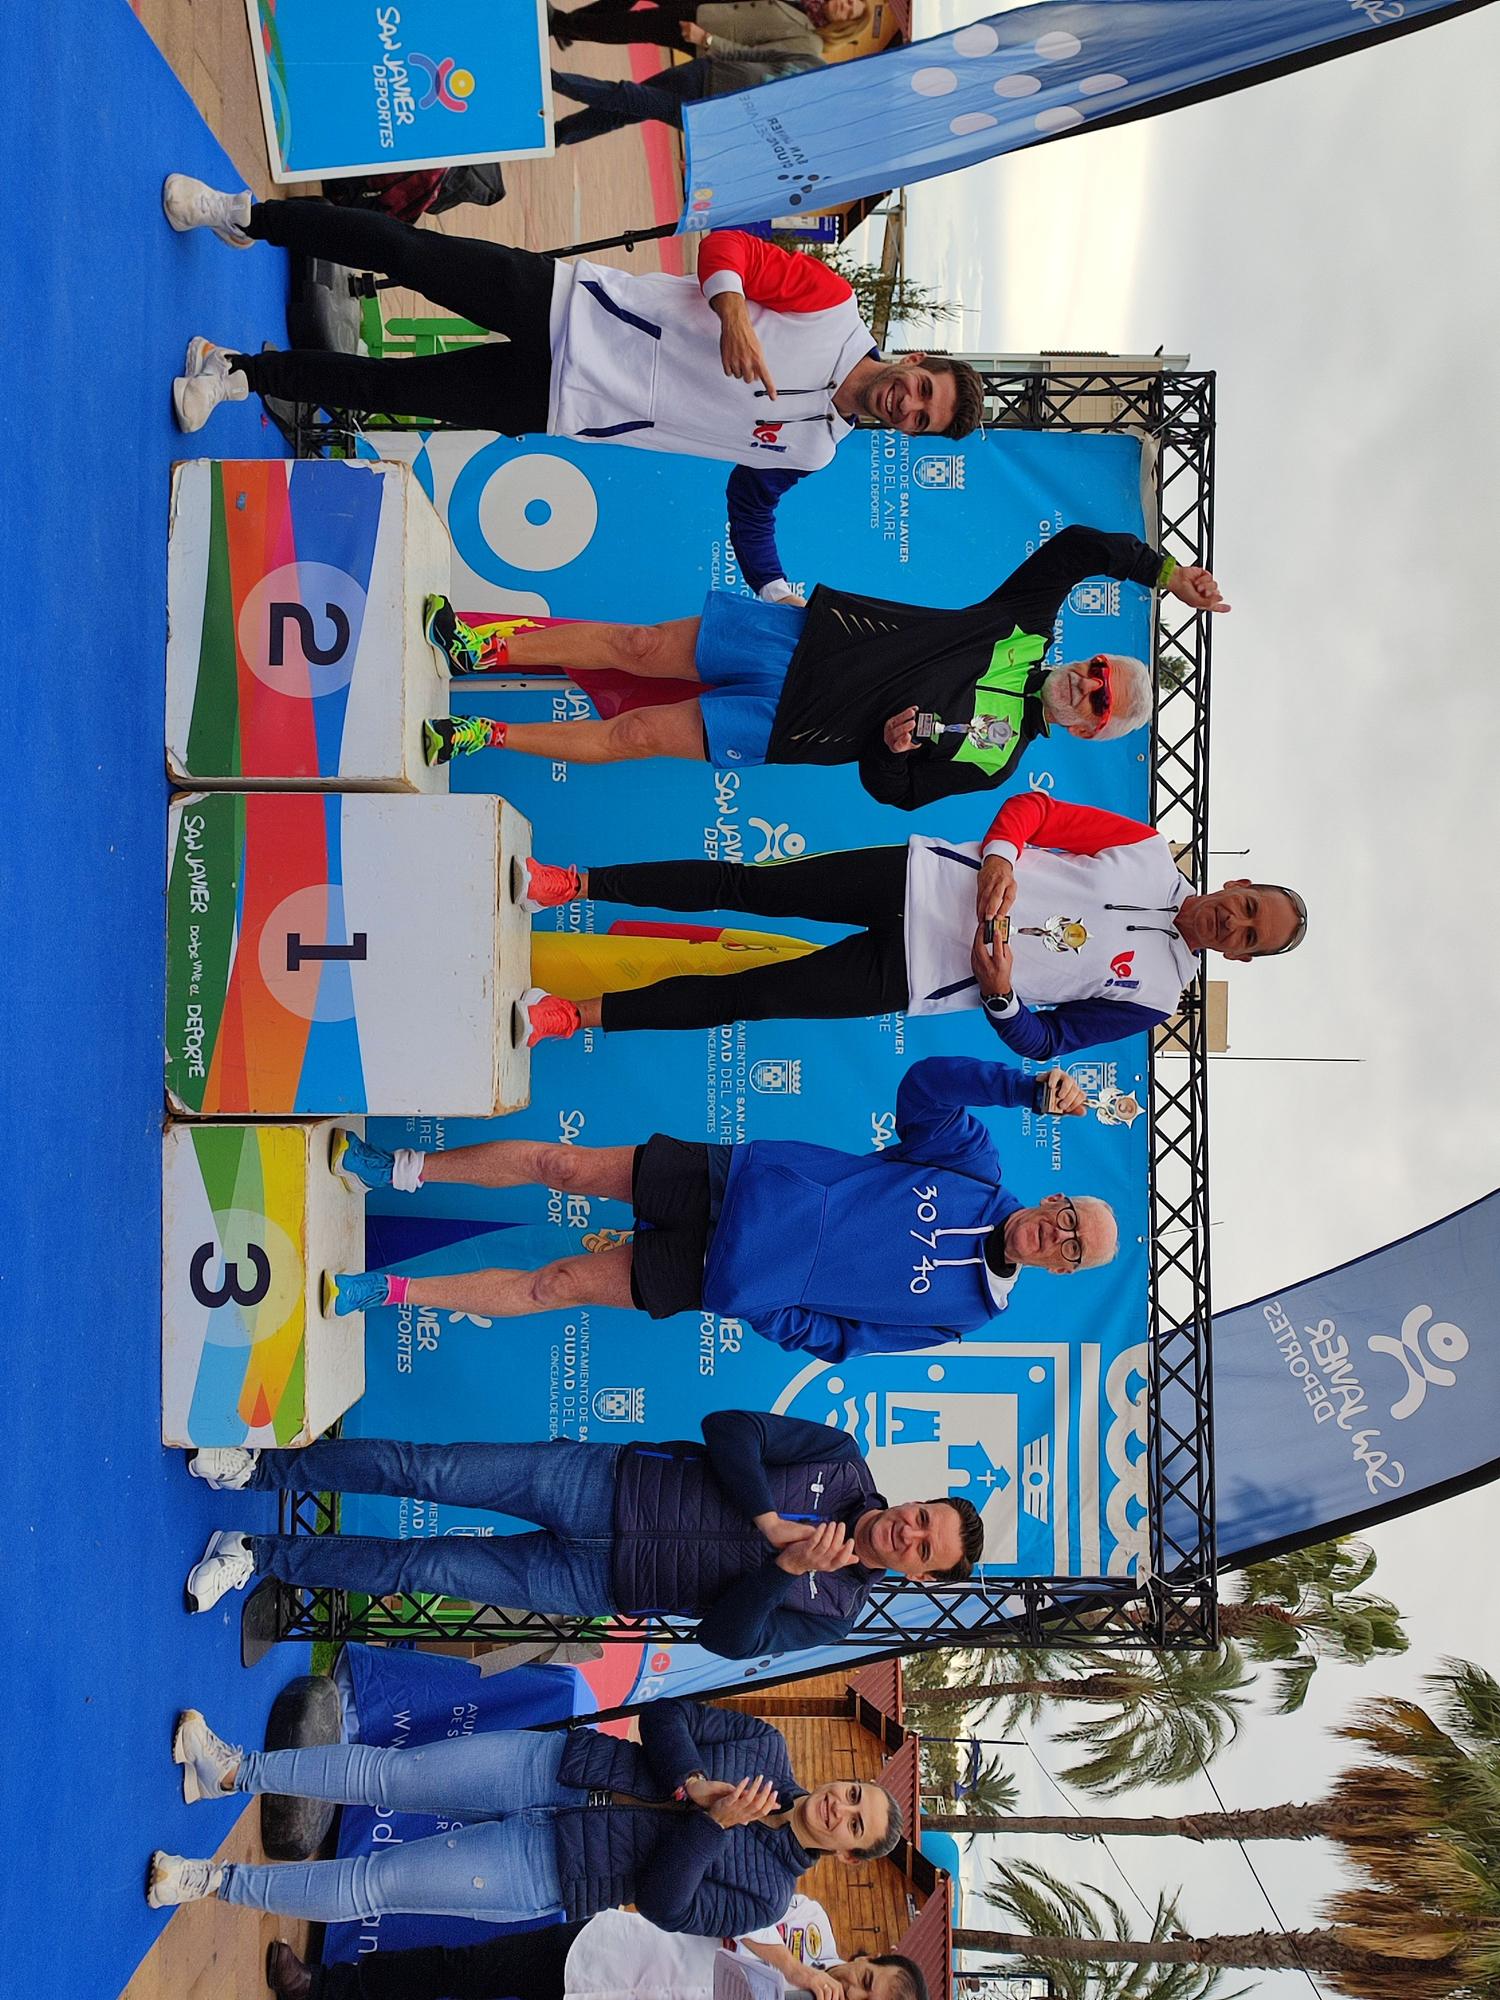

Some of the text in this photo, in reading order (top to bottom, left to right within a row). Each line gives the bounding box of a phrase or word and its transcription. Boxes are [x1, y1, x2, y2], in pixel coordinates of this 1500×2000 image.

[376, 6, 415, 126] SAN JAVIER
[372, 65, 394, 148] DEPORTES
[870, 470, 880, 482] DE
[883, 464, 896, 494] DEL
[899, 474, 909, 489] DE
[870, 483, 880, 529] DEPORTES
[899, 492, 909, 517] SAN
[899, 520, 909, 563] JAVIER
[268, 602, 350, 667] 2
[992, 727, 1008, 738] 2
[714, 772, 740, 815] SAN
[183, 815, 205, 850] SAN
[184, 852, 210, 914] JAVIER
[286, 932, 367, 971] 1
[182, 1004, 205, 1079] DEPORTE
[584, 1026, 593, 1053] VIER
[879, 1014, 891, 1033] RE
[707, 1074, 716, 1086] DE
[721, 1068, 732, 1098] DEL
[736, 1079, 746, 1094] DE
[707, 1088, 716, 1133] DEPORTES
[736, 1097, 745, 1121] SAN
[1021, 1107, 1031, 1136] ORTES
[1051, 1127, 1061, 1171] JAVIER
[567, 1195, 591, 1228] IER
[189, 1241, 271, 1309] 3
[397, 1304, 412, 1374] EPORTES
[416, 1306, 440, 1351] VIER
[699, 1311, 715, 1376] PORTES
[719, 1318, 743, 1353] IER
[562, 1324, 576, 1427] CIUDAD DEL
[578, 1311, 590, 1442] AYUNTAMIENTO DE SA
[550, 1402, 559, 1415] DE
